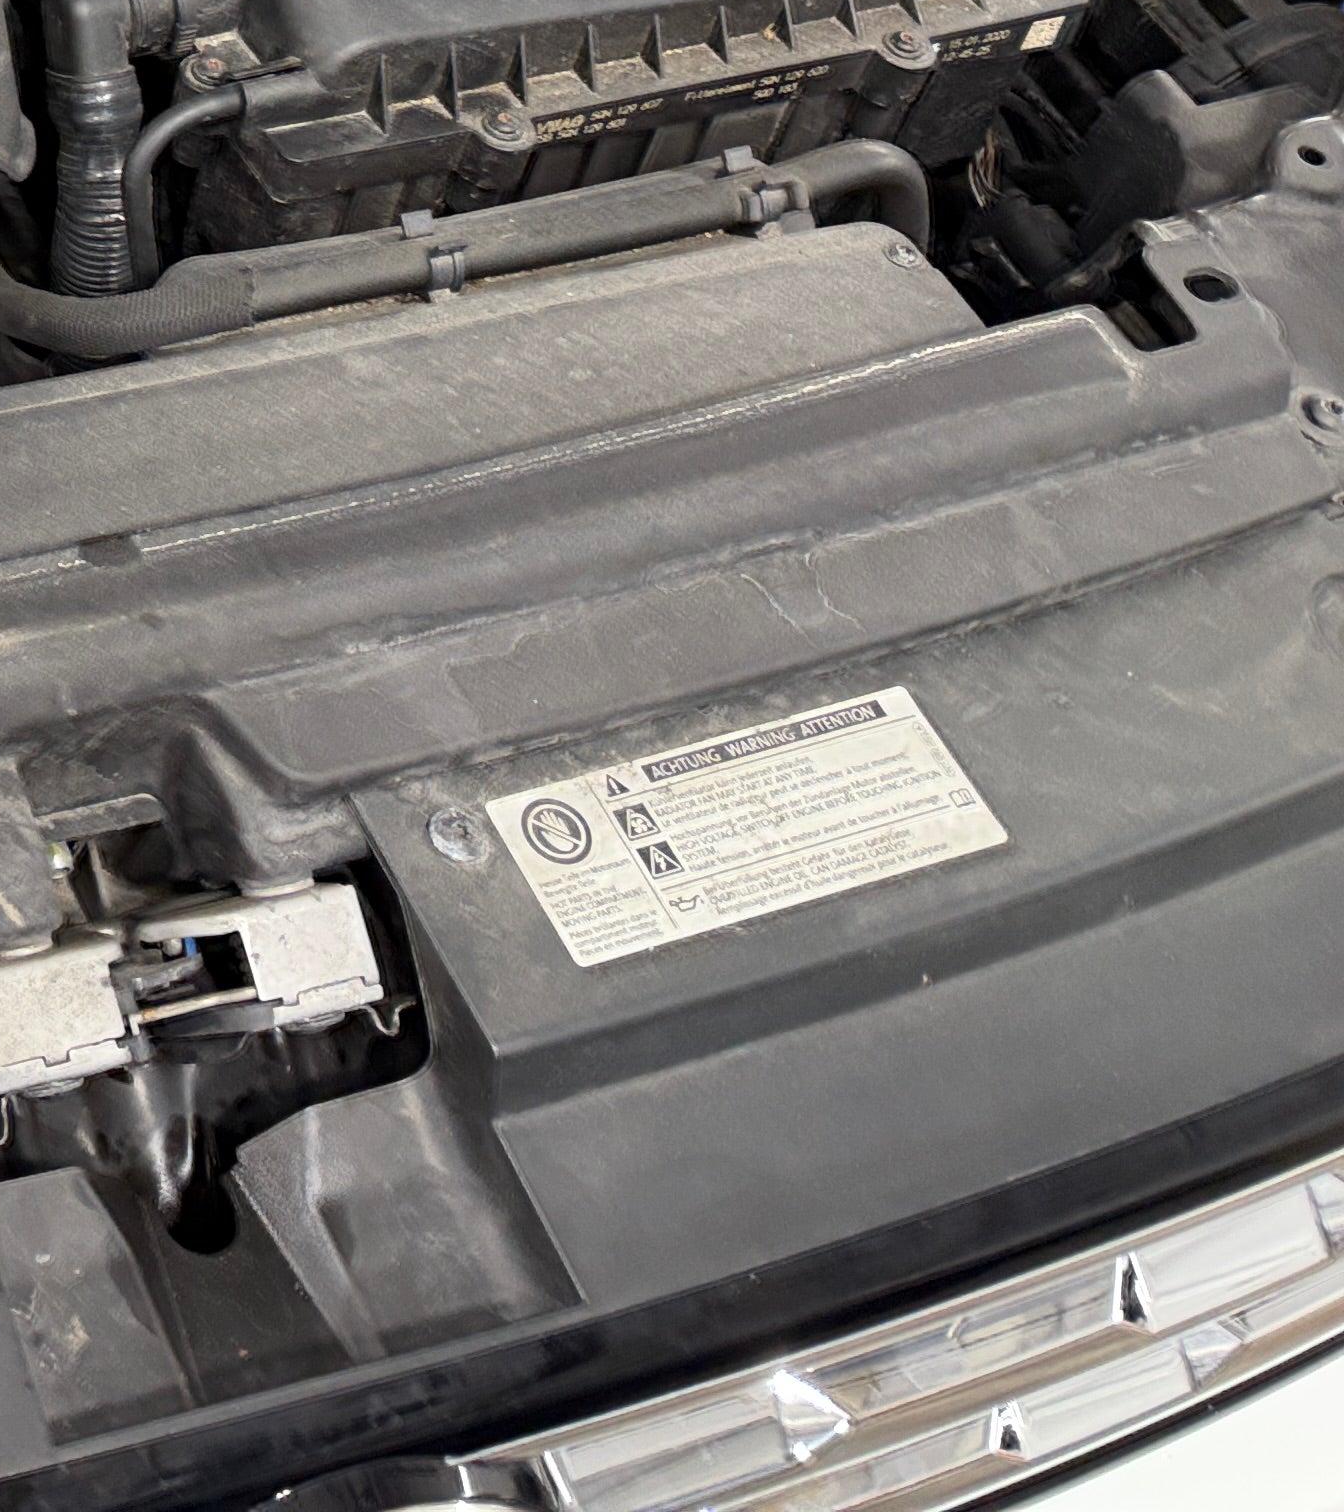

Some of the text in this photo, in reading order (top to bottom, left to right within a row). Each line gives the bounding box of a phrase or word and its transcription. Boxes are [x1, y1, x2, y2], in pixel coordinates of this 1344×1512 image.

[647, 703, 877, 779] ACHTUNG WARNING ATTENTION
